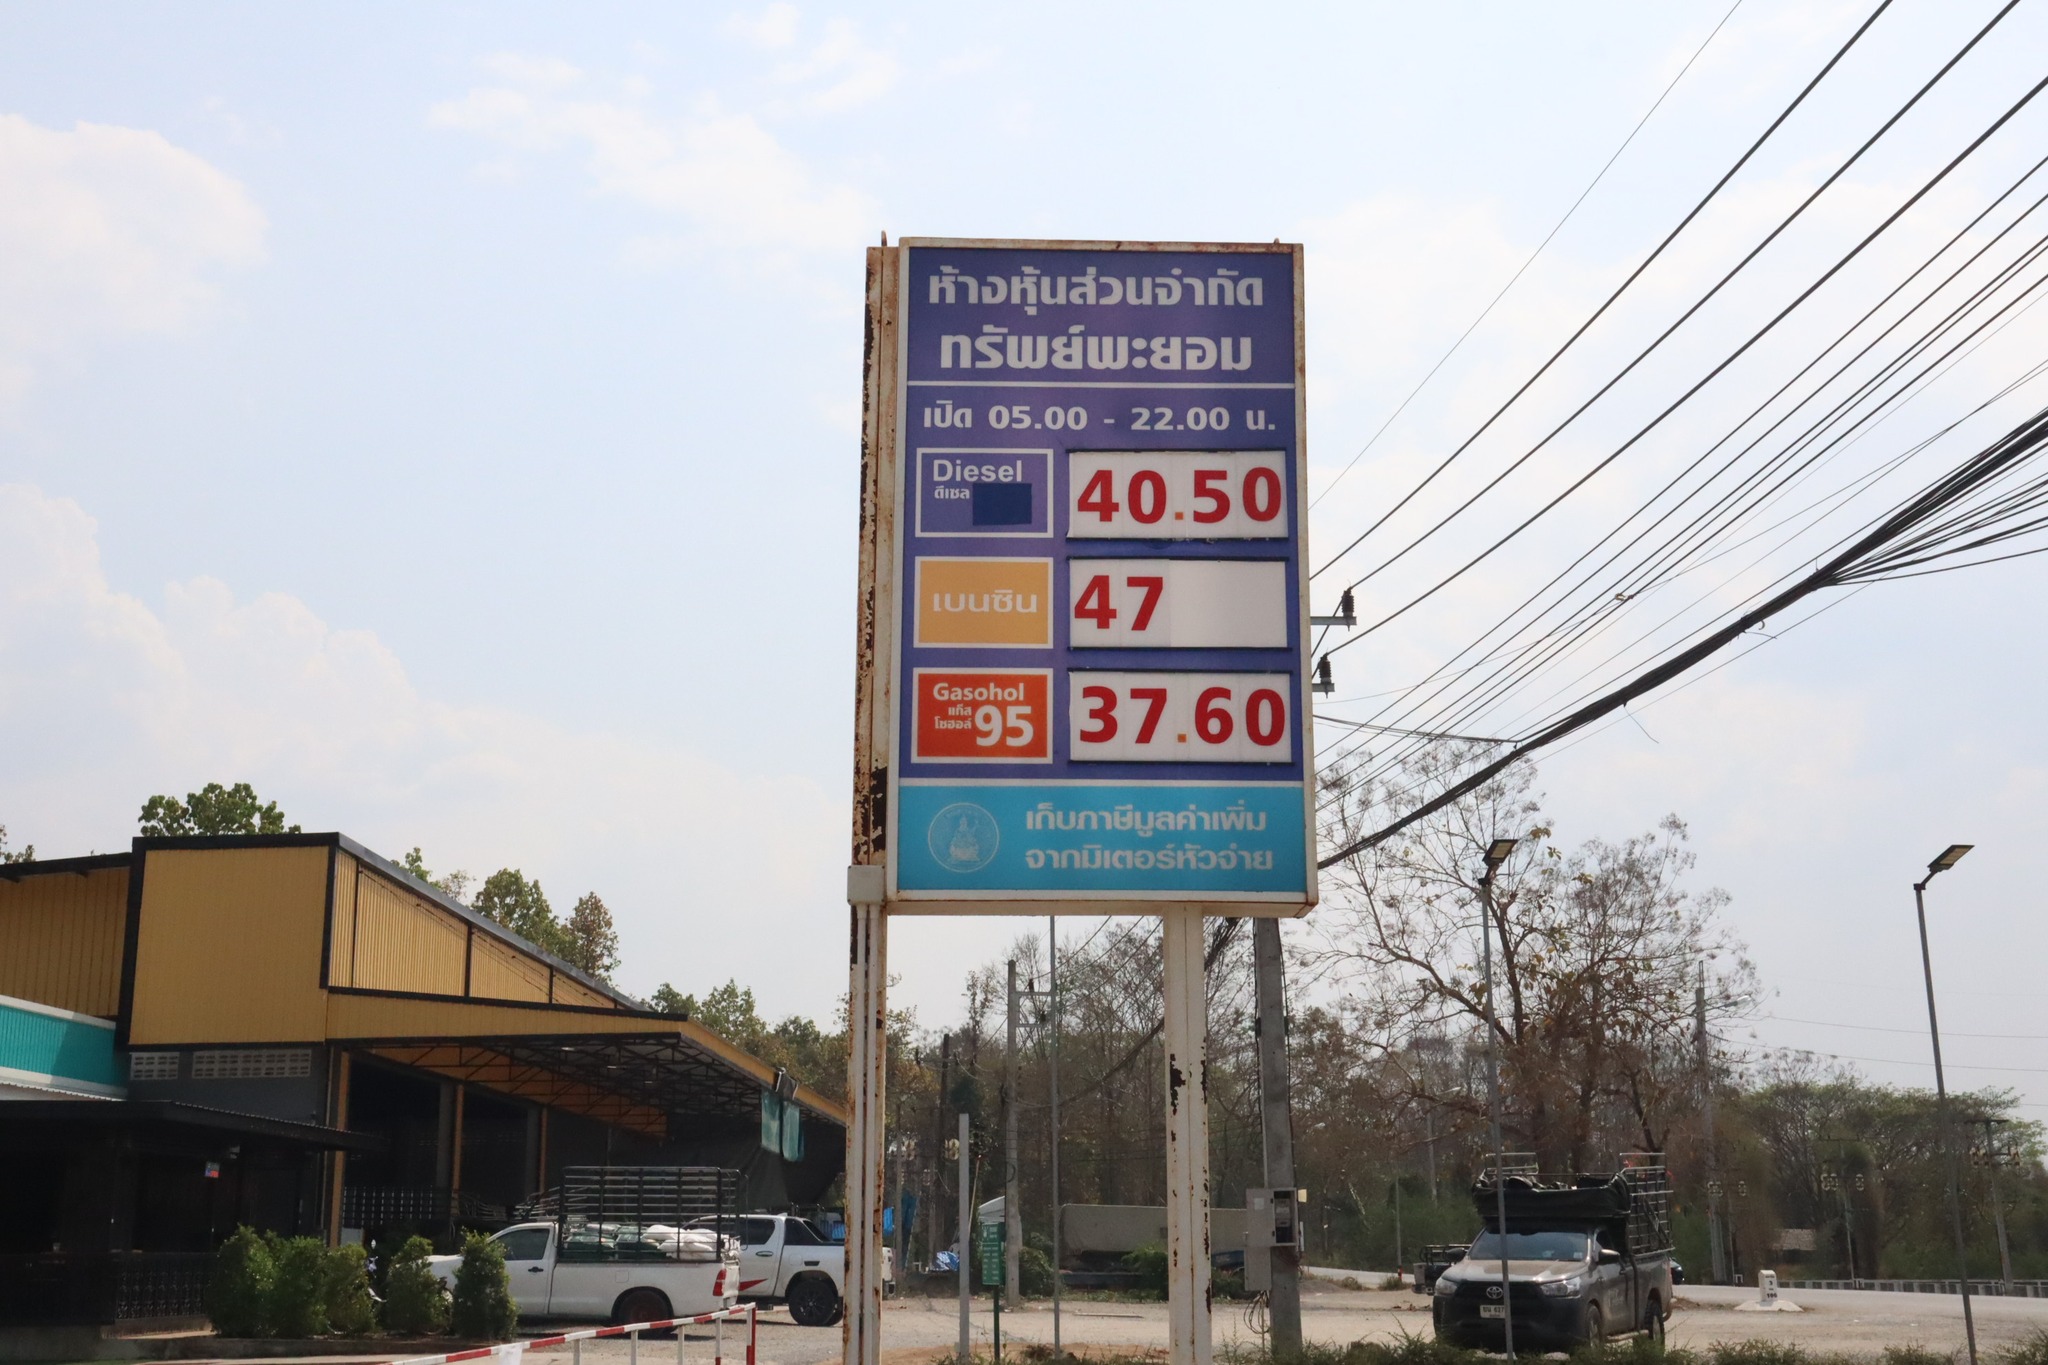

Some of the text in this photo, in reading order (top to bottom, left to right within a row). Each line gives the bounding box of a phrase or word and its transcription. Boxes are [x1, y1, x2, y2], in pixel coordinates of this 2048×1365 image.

[929, 265, 1263, 316] ห้างหุ้นส่วนจำกัด
[940, 324, 1252, 370] ทรัพย์พะยอม
[923, 400, 972, 428] เปิด
[988, 406, 1088, 430] 05.00
[1130, 407, 1230, 431] 22.00
[1246, 410, 1276, 431] น.
[933, 459, 1022, 482] Diesel
[934, 486, 970, 499] ดีเซล
[1077, 467, 1282, 524] 40.50
[933, 589, 1037, 613] เบนซิน
[1074, 575, 1164, 631] 47
[932, 682, 1025, 701] Gasohol
[974, 704, 1034, 747] 95
[1079, 686, 1286, 746] 37.60
[1026, 799, 1267, 837] เก็บภาษีมูลค่าเพิ่ม
[1025, 843, 1273, 870] จากมิเตอร์หัวจ่าย
